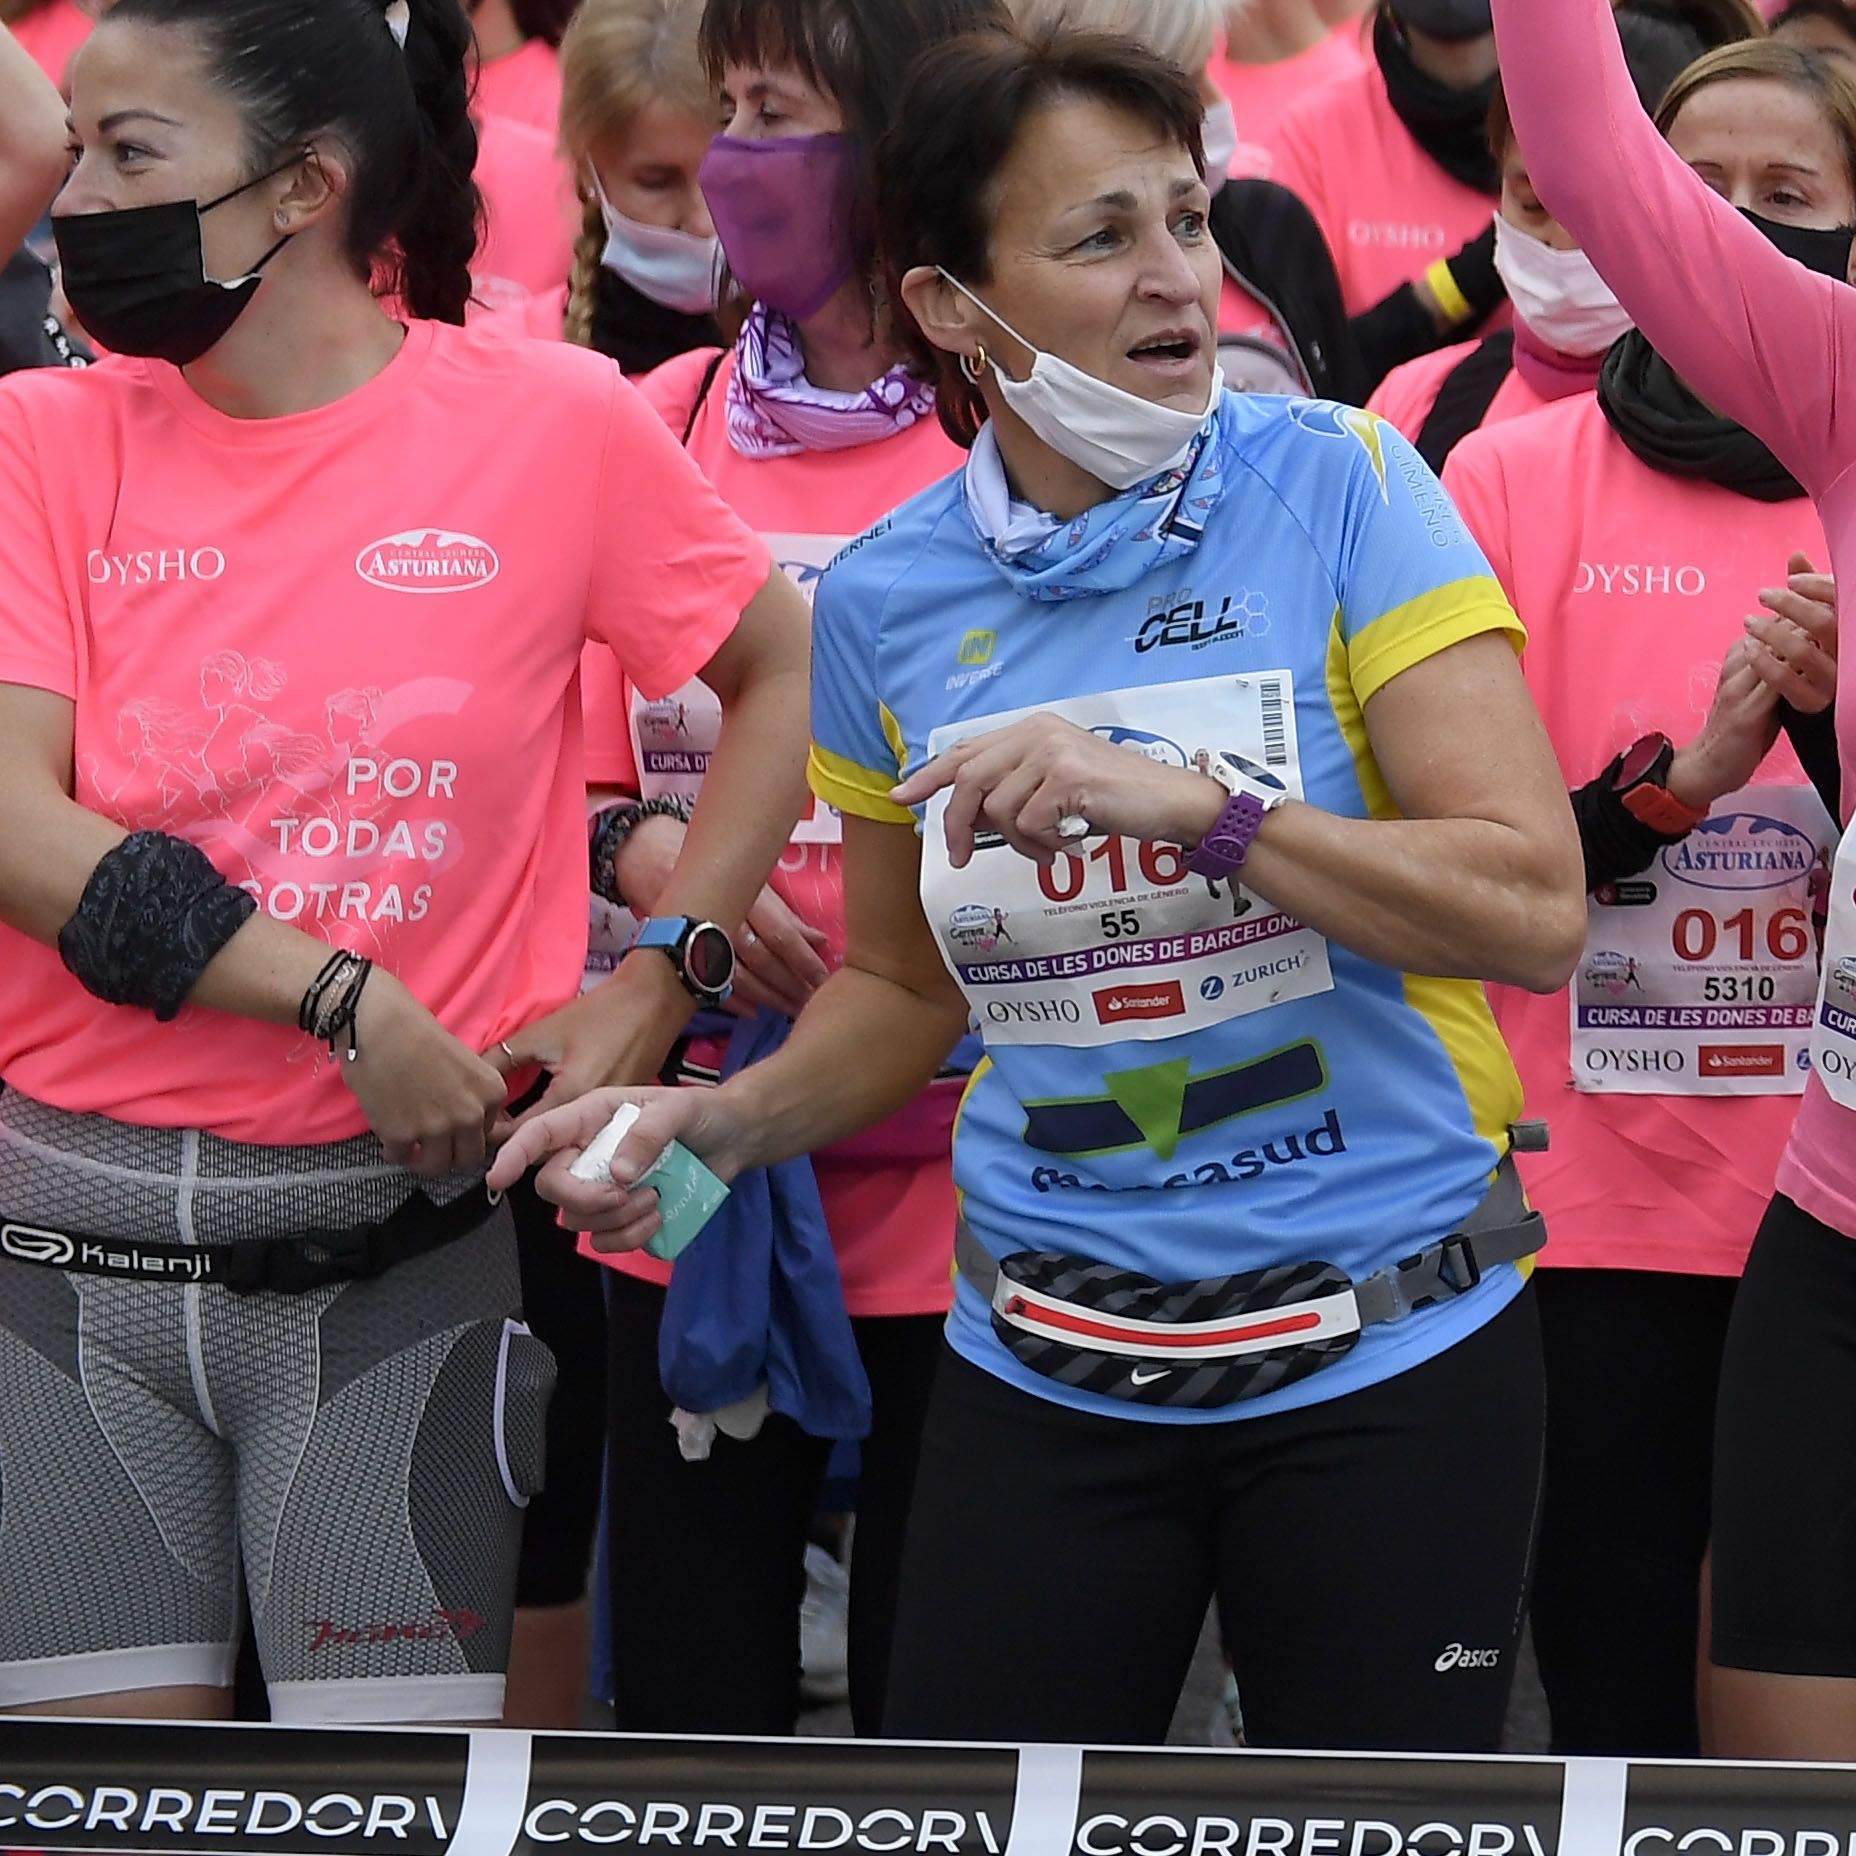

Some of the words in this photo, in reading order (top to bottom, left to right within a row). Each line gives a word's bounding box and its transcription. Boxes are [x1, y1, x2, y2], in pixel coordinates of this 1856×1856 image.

[88, 546, 225, 585] OYSHO
[367, 553, 488, 578] ASTURIANA
[1135, 597, 1238, 653] CELL
[347, 758, 458, 799] POR
[271, 819, 446, 860] TODAS
[1674, 842, 1806, 871] ASTURIANA
[1038, 833, 1188, 902] 016
[1101, 910, 1139, 938] 55
[1672, 908, 1809, 962] 016
[968, 961, 1024, 982] CURSA
[1027, 957, 1049, 977] DE
[1051, 952, 1087, 974] LES
[1094, 943, 1154, 968] DONES
[1160, 938, 1185, 960] DE
[1191, 914, 1301, 954] BARCELON
[987, 999, 1080, 1024] OYSHO
[1122, 992, 1171, 1010] Santander
[1233, 956, 1300, 987] ZURICH
[1704, 976, 1774, 1001] 5310
[1587, 1007, 1640, 1025] CURSA
[1645, 1007, 1668, 1025] DE
[1670, 1008, 1702, 1025] LES
[1707, 1008, 1766, 1025] DONES
[1771, 1008, 1792, 1025] DE
[1586, 1048, 1684, 1072] OYSHO
[82, 1242, 211, 1280] Kalenji
